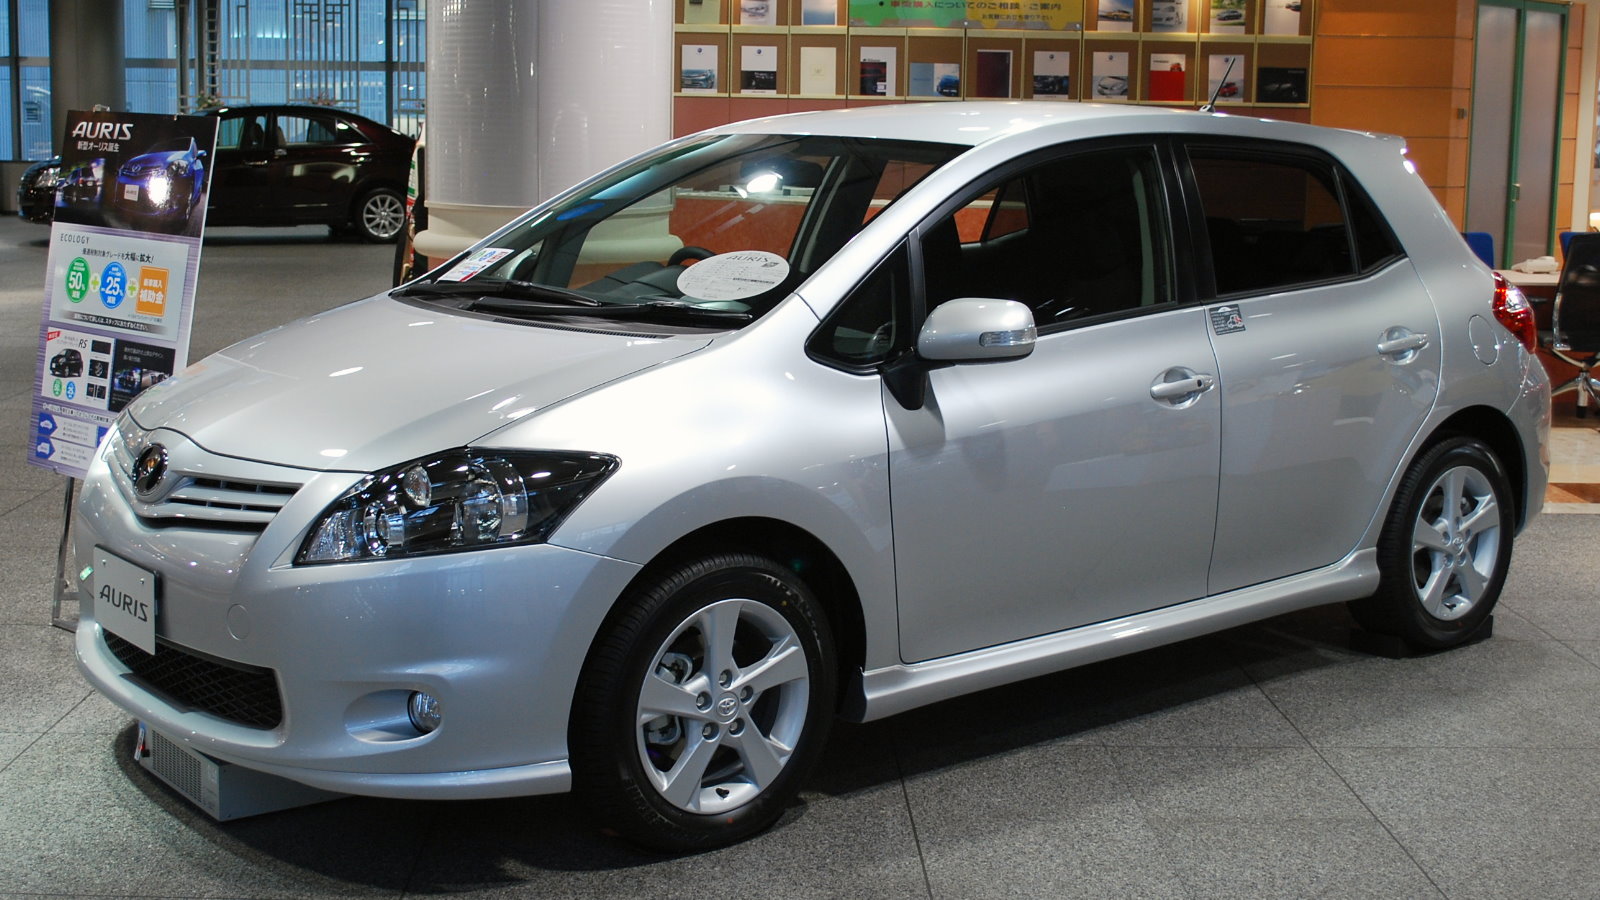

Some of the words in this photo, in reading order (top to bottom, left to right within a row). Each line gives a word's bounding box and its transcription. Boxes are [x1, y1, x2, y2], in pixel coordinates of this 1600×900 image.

[72, 121, 134, 141] AURIS
[77, 141, 120, 153] 新型オーリス誕生
[60, 233, 90, 244] ECOLOGY
[139, 288, 164, 305] 補助金
[78, 338, 88, 349] RS
[99, 584, 149, 622] AURIS
